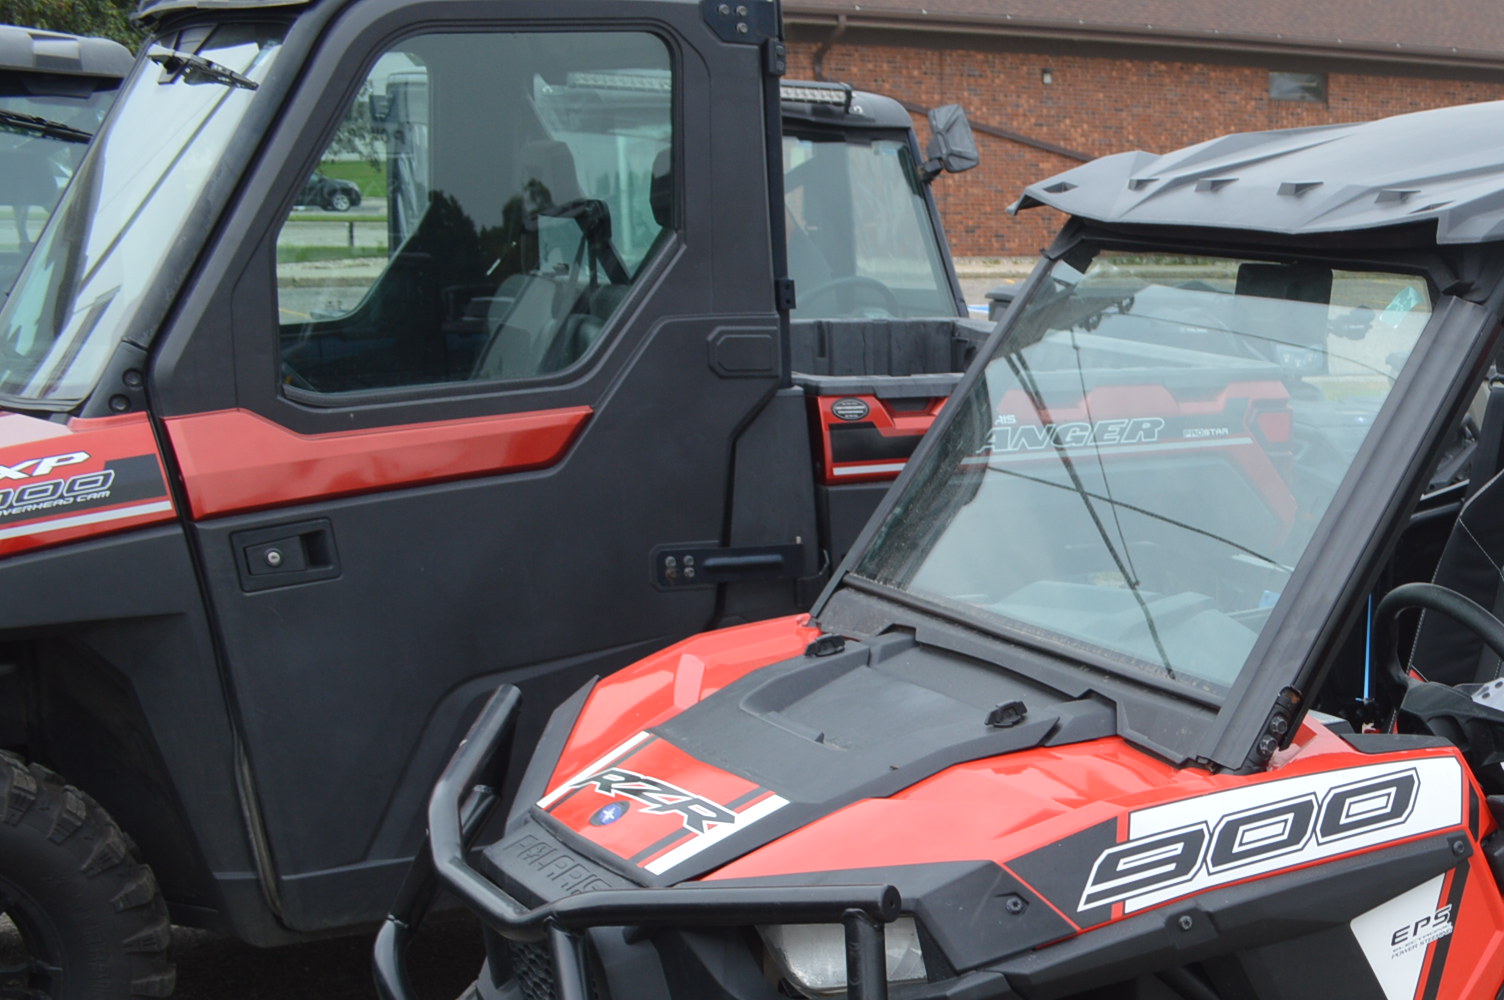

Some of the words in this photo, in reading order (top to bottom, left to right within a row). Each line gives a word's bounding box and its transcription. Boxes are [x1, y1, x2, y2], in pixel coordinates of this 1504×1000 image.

[976, 417, 1165, 454] ANGER
[0, 450, 92, 480] XP
[0, 469, 115, 510] 00
[76, 490, 111, 502] CAM
[568, 766, 737, 836] RZR
[1077, 767, 1421, 912] 900
[1390, 903, 1453, 947] EPS
